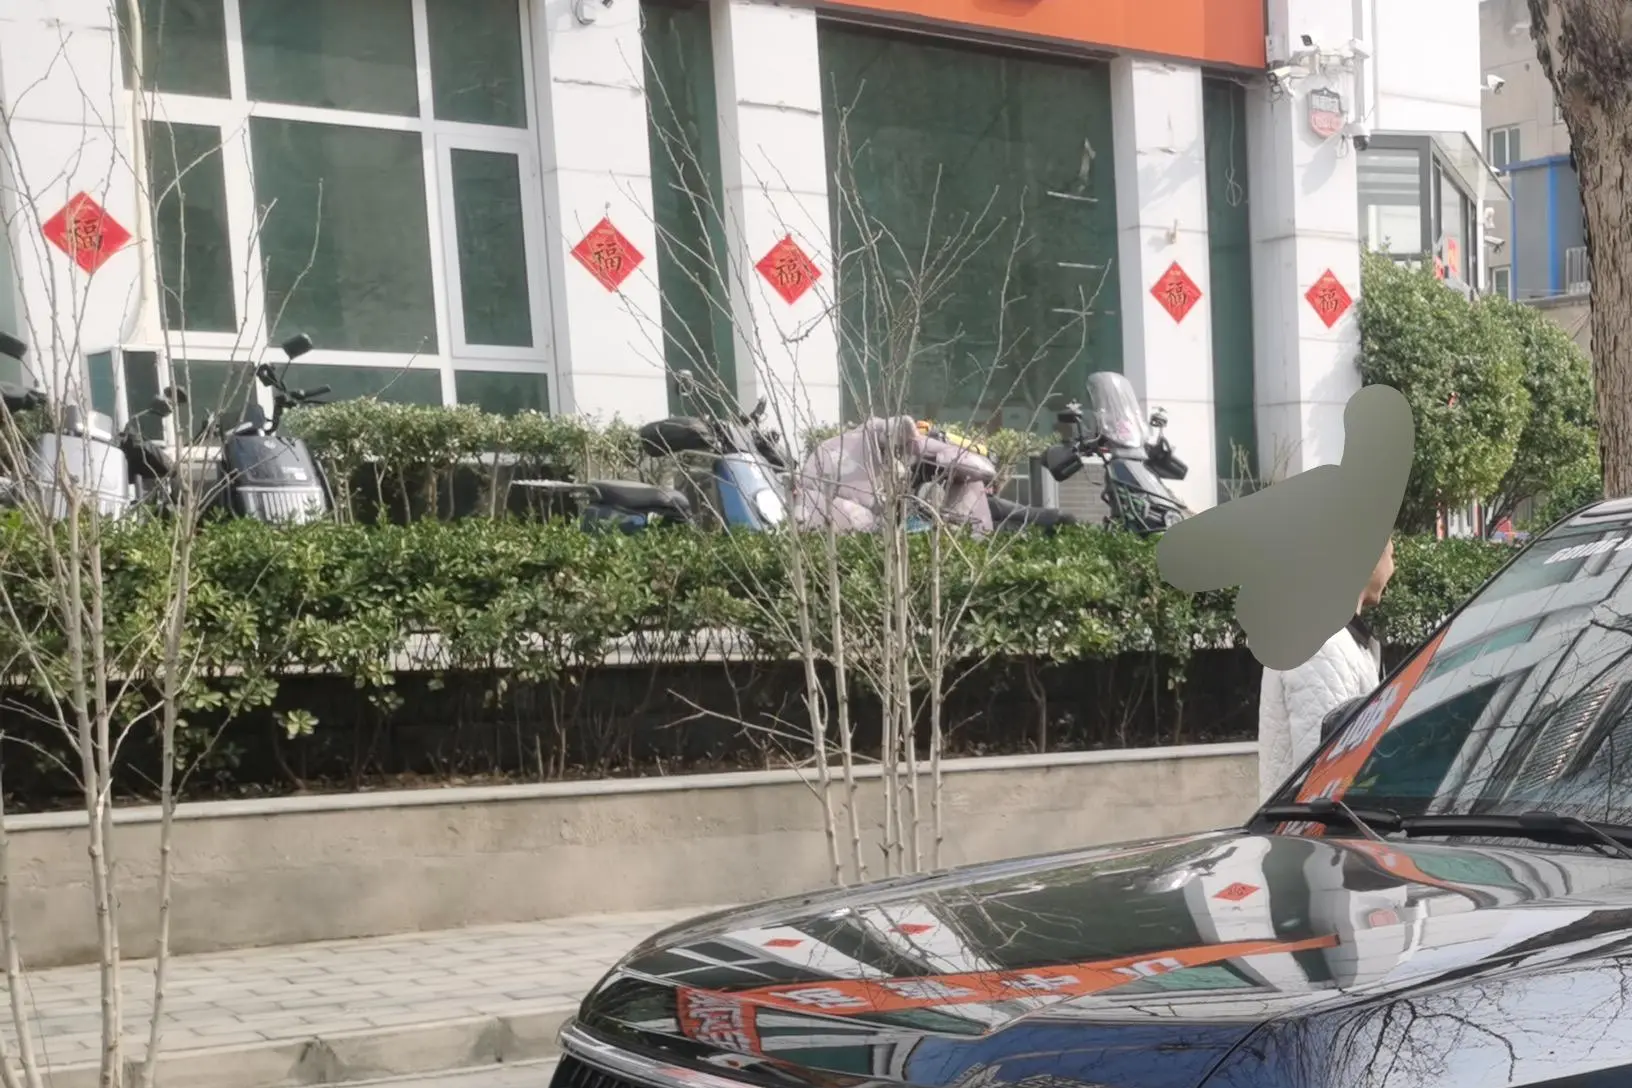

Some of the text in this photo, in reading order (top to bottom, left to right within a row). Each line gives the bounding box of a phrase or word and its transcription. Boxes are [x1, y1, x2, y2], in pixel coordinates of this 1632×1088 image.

[66, 218, 104, 252] 福
[591, 240, 623, 273] 福
[775, 257, 802, 287] 福
[1164, 280, 1188, 308] 福
[1318, 287, 1338, 313] 福
